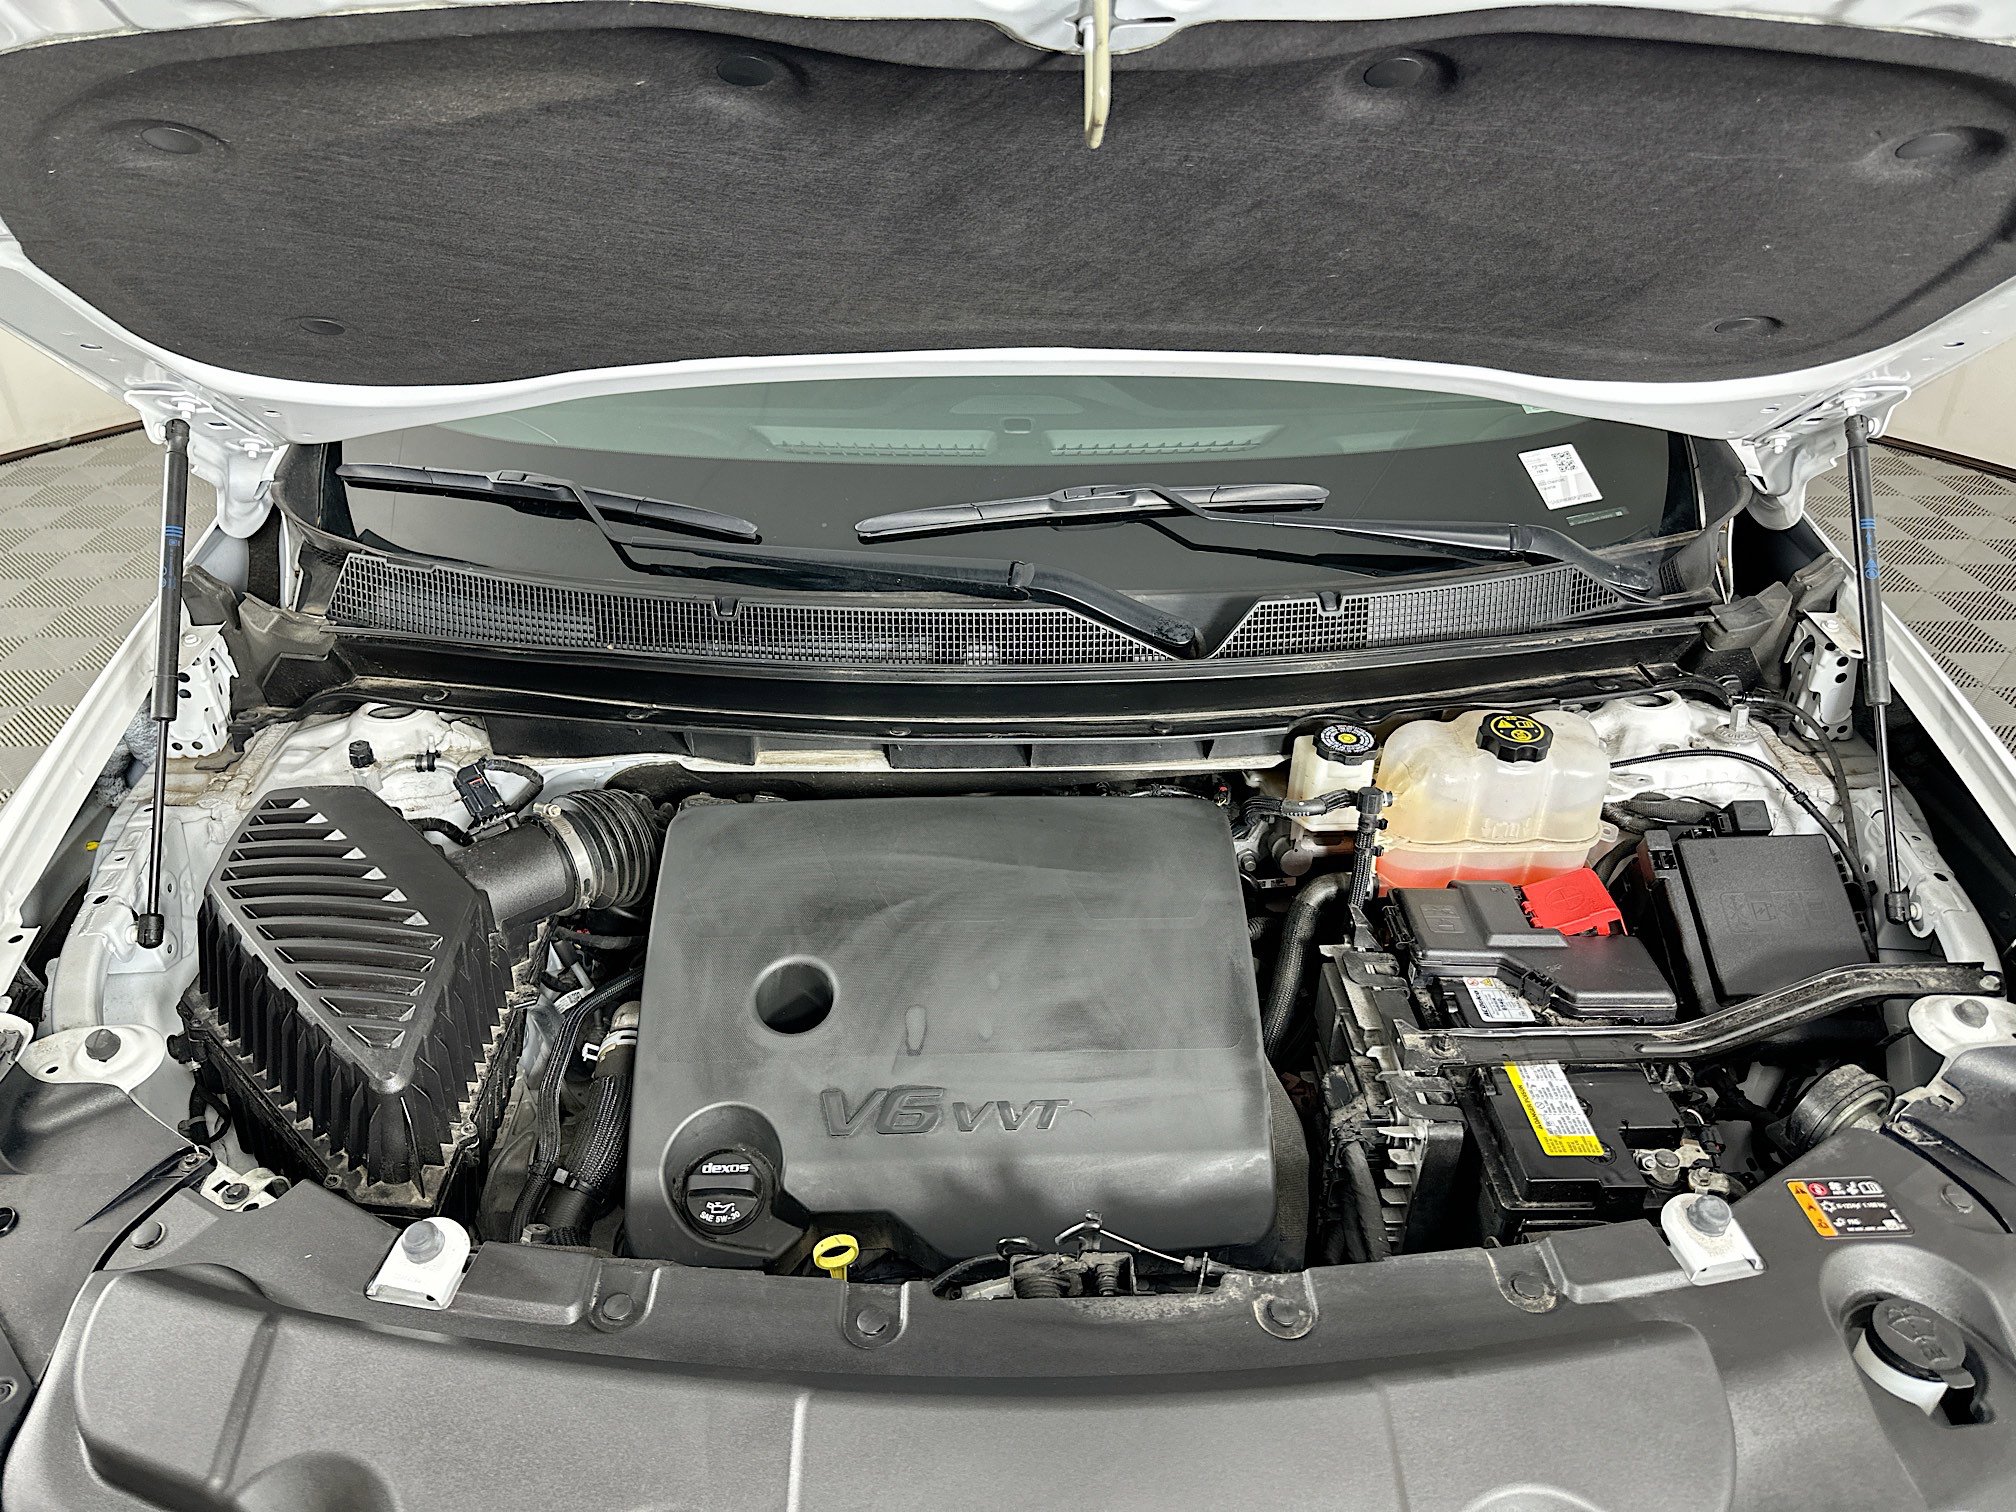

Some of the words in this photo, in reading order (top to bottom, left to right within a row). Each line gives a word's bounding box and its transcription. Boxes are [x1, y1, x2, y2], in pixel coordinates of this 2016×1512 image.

[820, 1085, 946, 1137] V6
[952, 1099, 1073, 1132] VVT
[1527, 1103, 1541, 1126] DANGER
[701, 1163, 751, 1174] dexos
[699, 1211, 715, 1223] SAE
[715, 1210, 741, 1223] 5W-30
